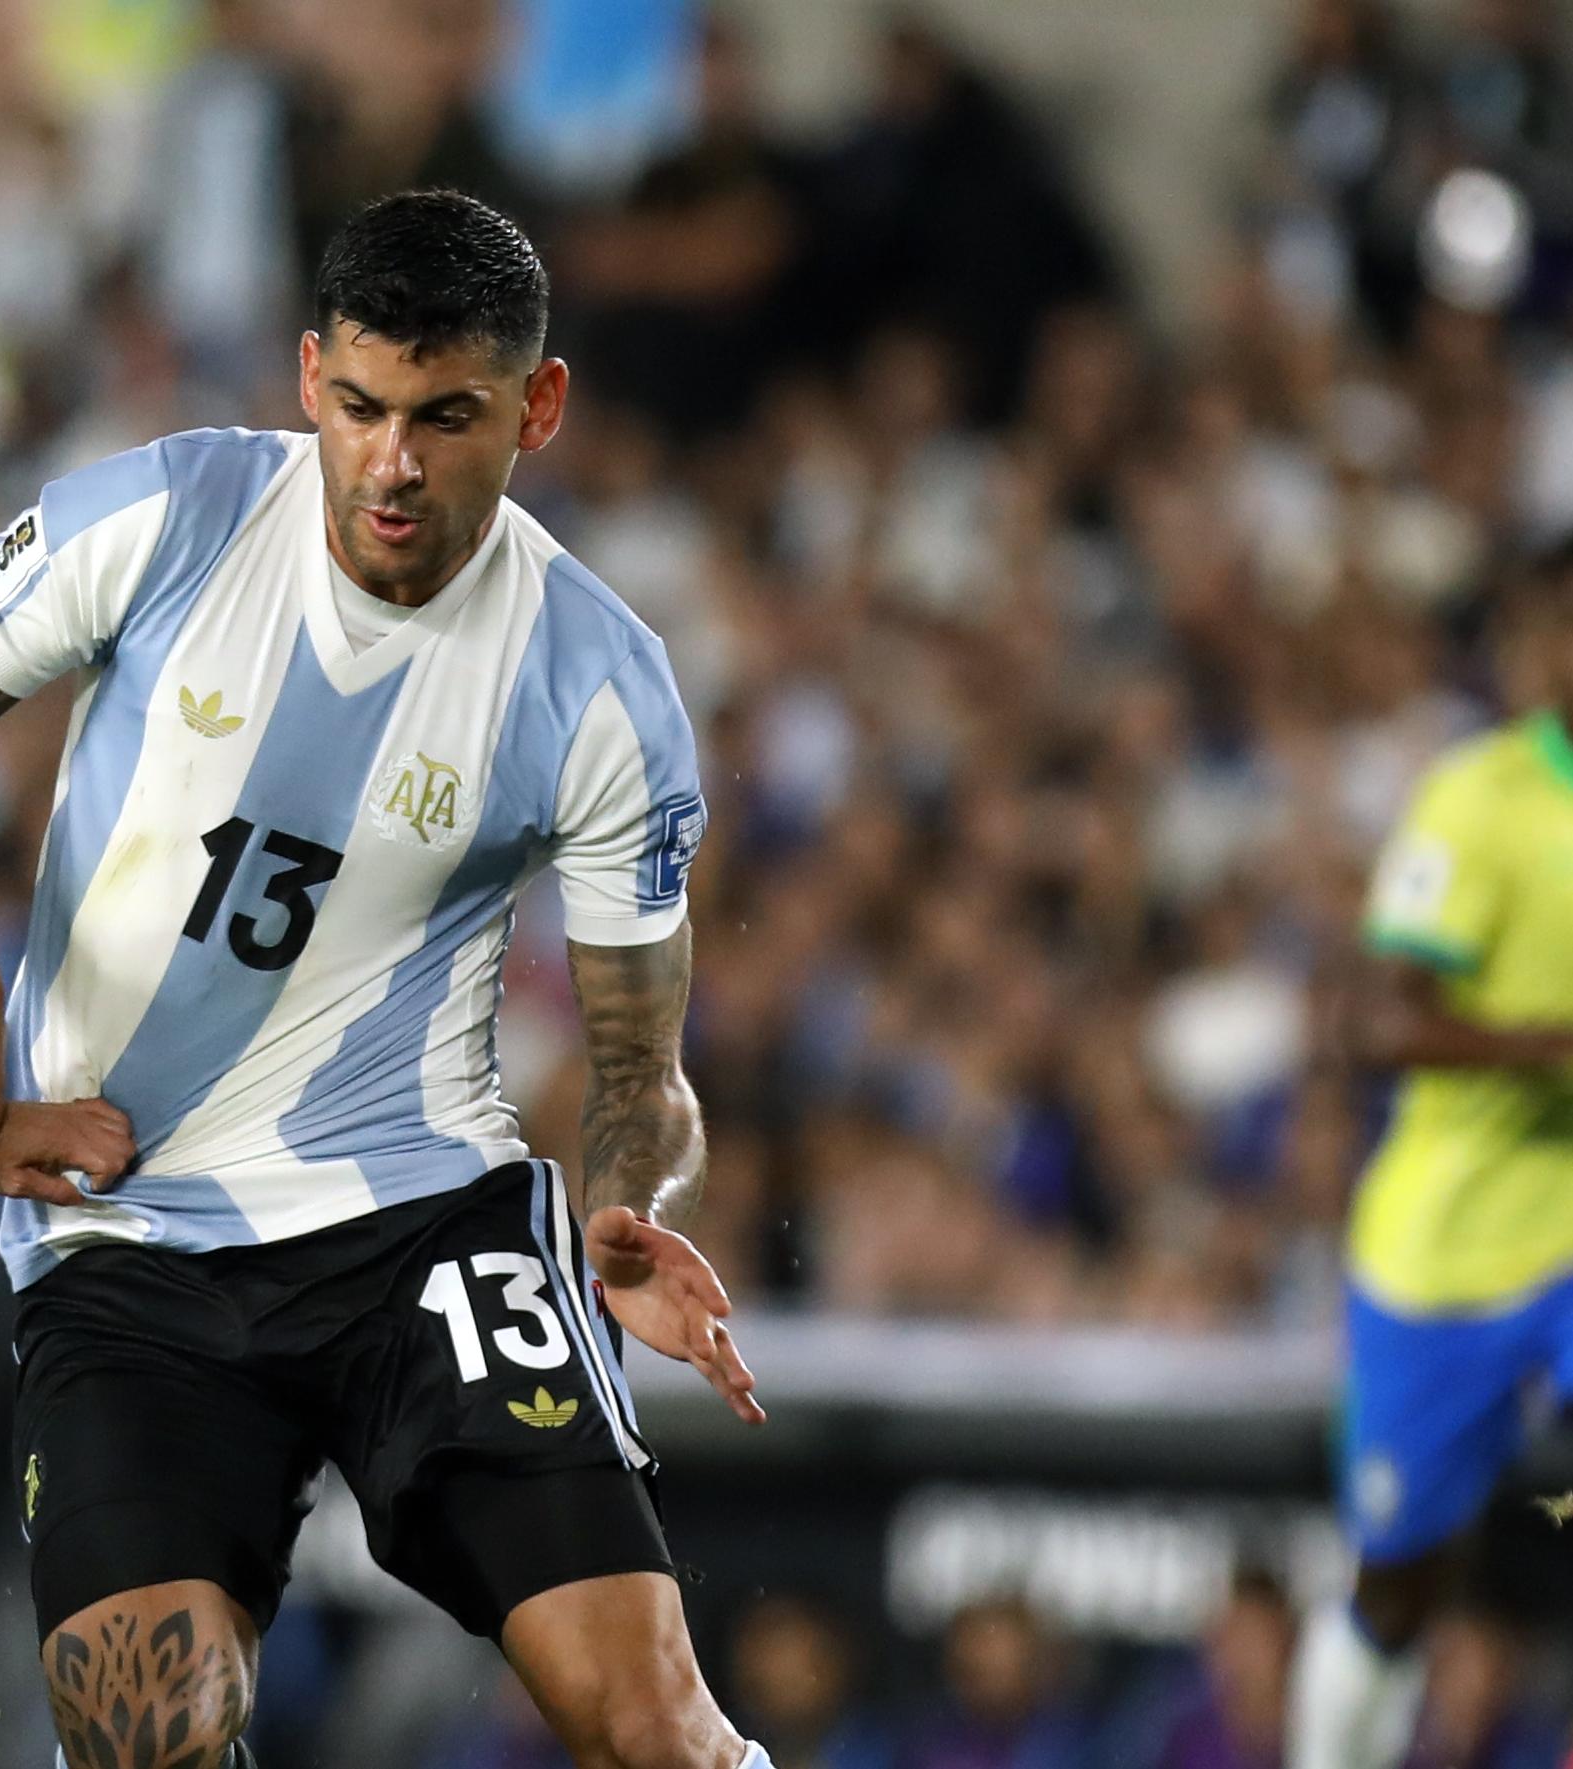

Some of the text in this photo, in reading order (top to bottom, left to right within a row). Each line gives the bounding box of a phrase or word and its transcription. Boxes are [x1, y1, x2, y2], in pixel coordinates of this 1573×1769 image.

[384, 751, 463, 844] AFA
[181, 815, 345, 972] 13
[418, 1251, 571, 1384] 13
